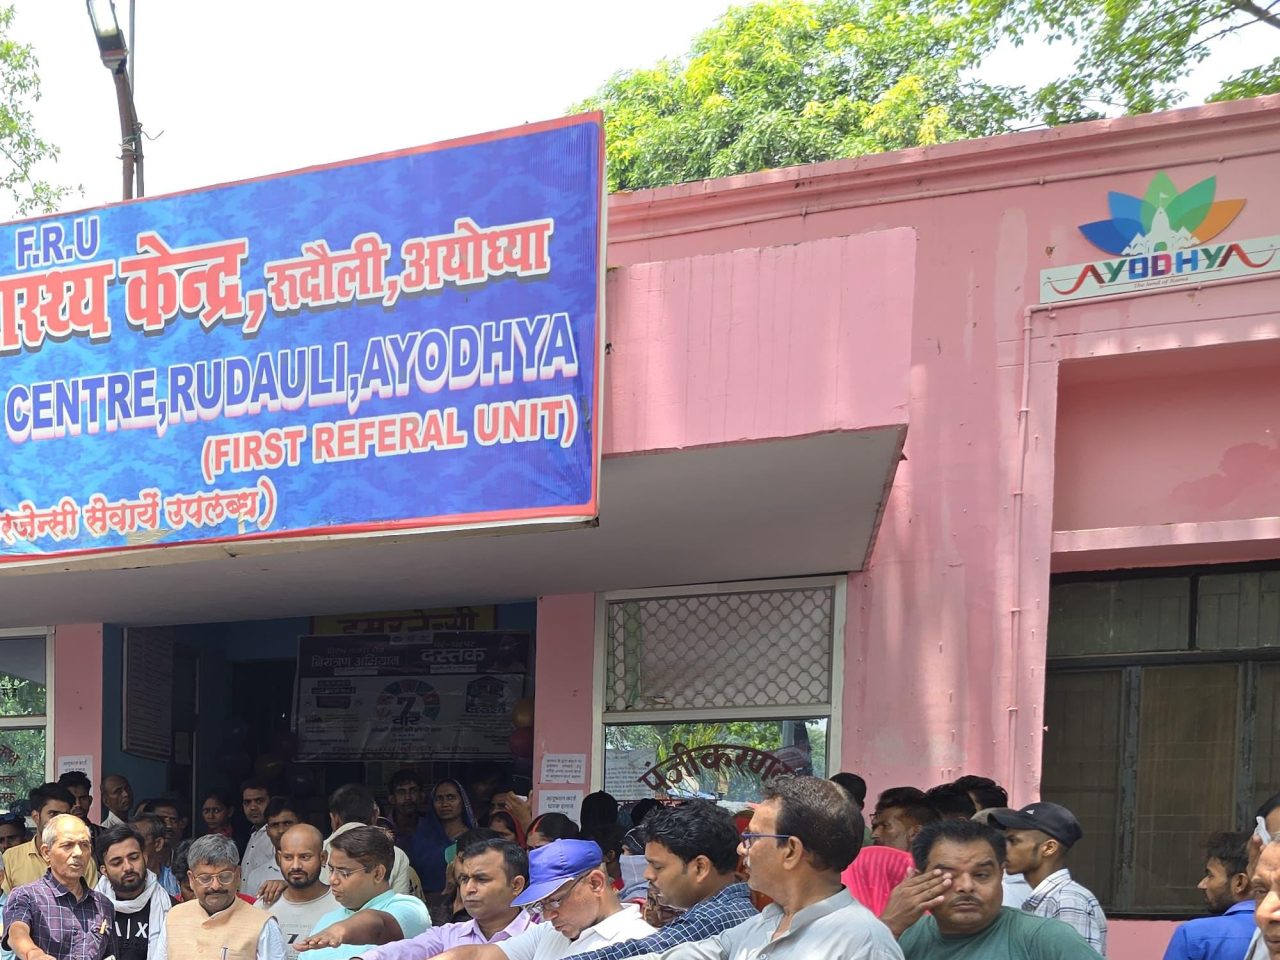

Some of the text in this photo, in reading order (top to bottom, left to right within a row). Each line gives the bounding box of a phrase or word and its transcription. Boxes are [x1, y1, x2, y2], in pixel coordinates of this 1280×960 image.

[15, 217, 99, 268] F.R.U
[1048, 243, 1274, 295] AYODHYA
[202, 394, 578, 484] (FIRST REFERAL UNIT)
